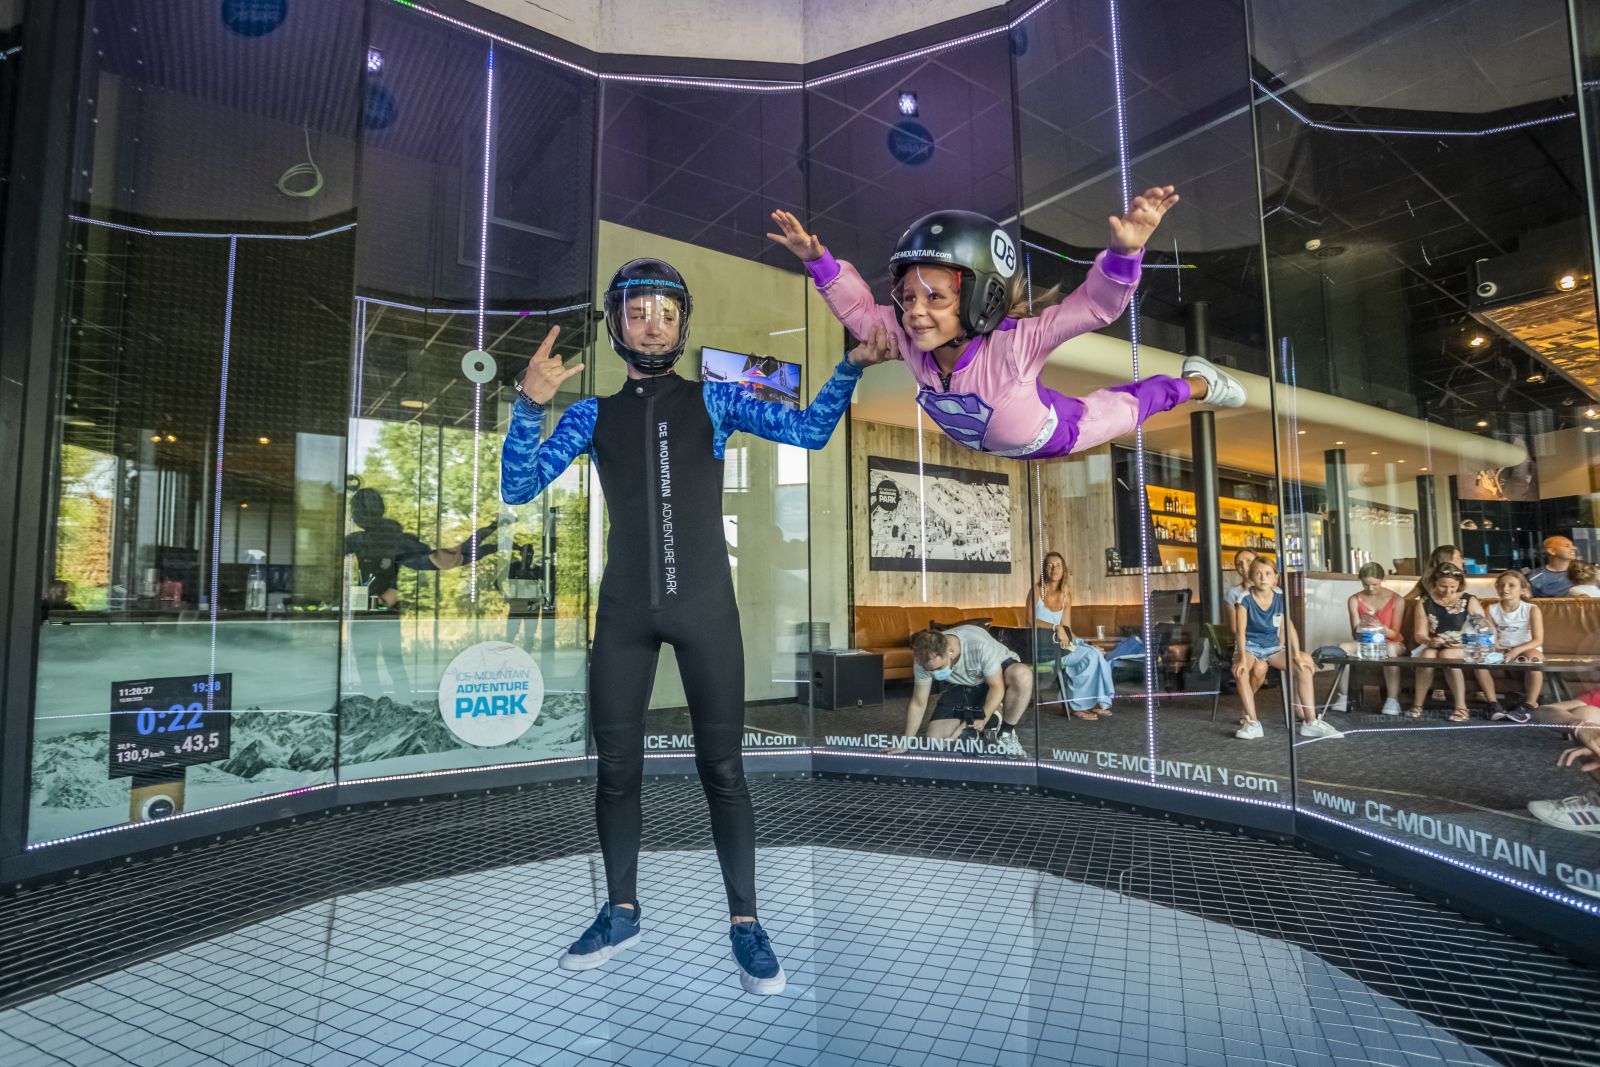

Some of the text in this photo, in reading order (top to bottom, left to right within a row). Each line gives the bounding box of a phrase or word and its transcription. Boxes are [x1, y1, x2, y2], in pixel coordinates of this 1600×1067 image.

[994, 235, 1014, 270] 08
[658, 422, 677, 595] ICE MOUNTAIN ADVENTURE PARK
[878, 494, 897, 504] PARK
[456, 681, 529, 694] ADVENTURE
[455, 694, 528, 719] PARK
[137, 702, 204, 735] 0:22
[182, 732, 219, 752] 43,5
[825, 734, 1023, 756] www.ICE-MOUNTAIN.com
[116, 748, 149, 762] 130,9
[1556, 862, 1600, 892] co
